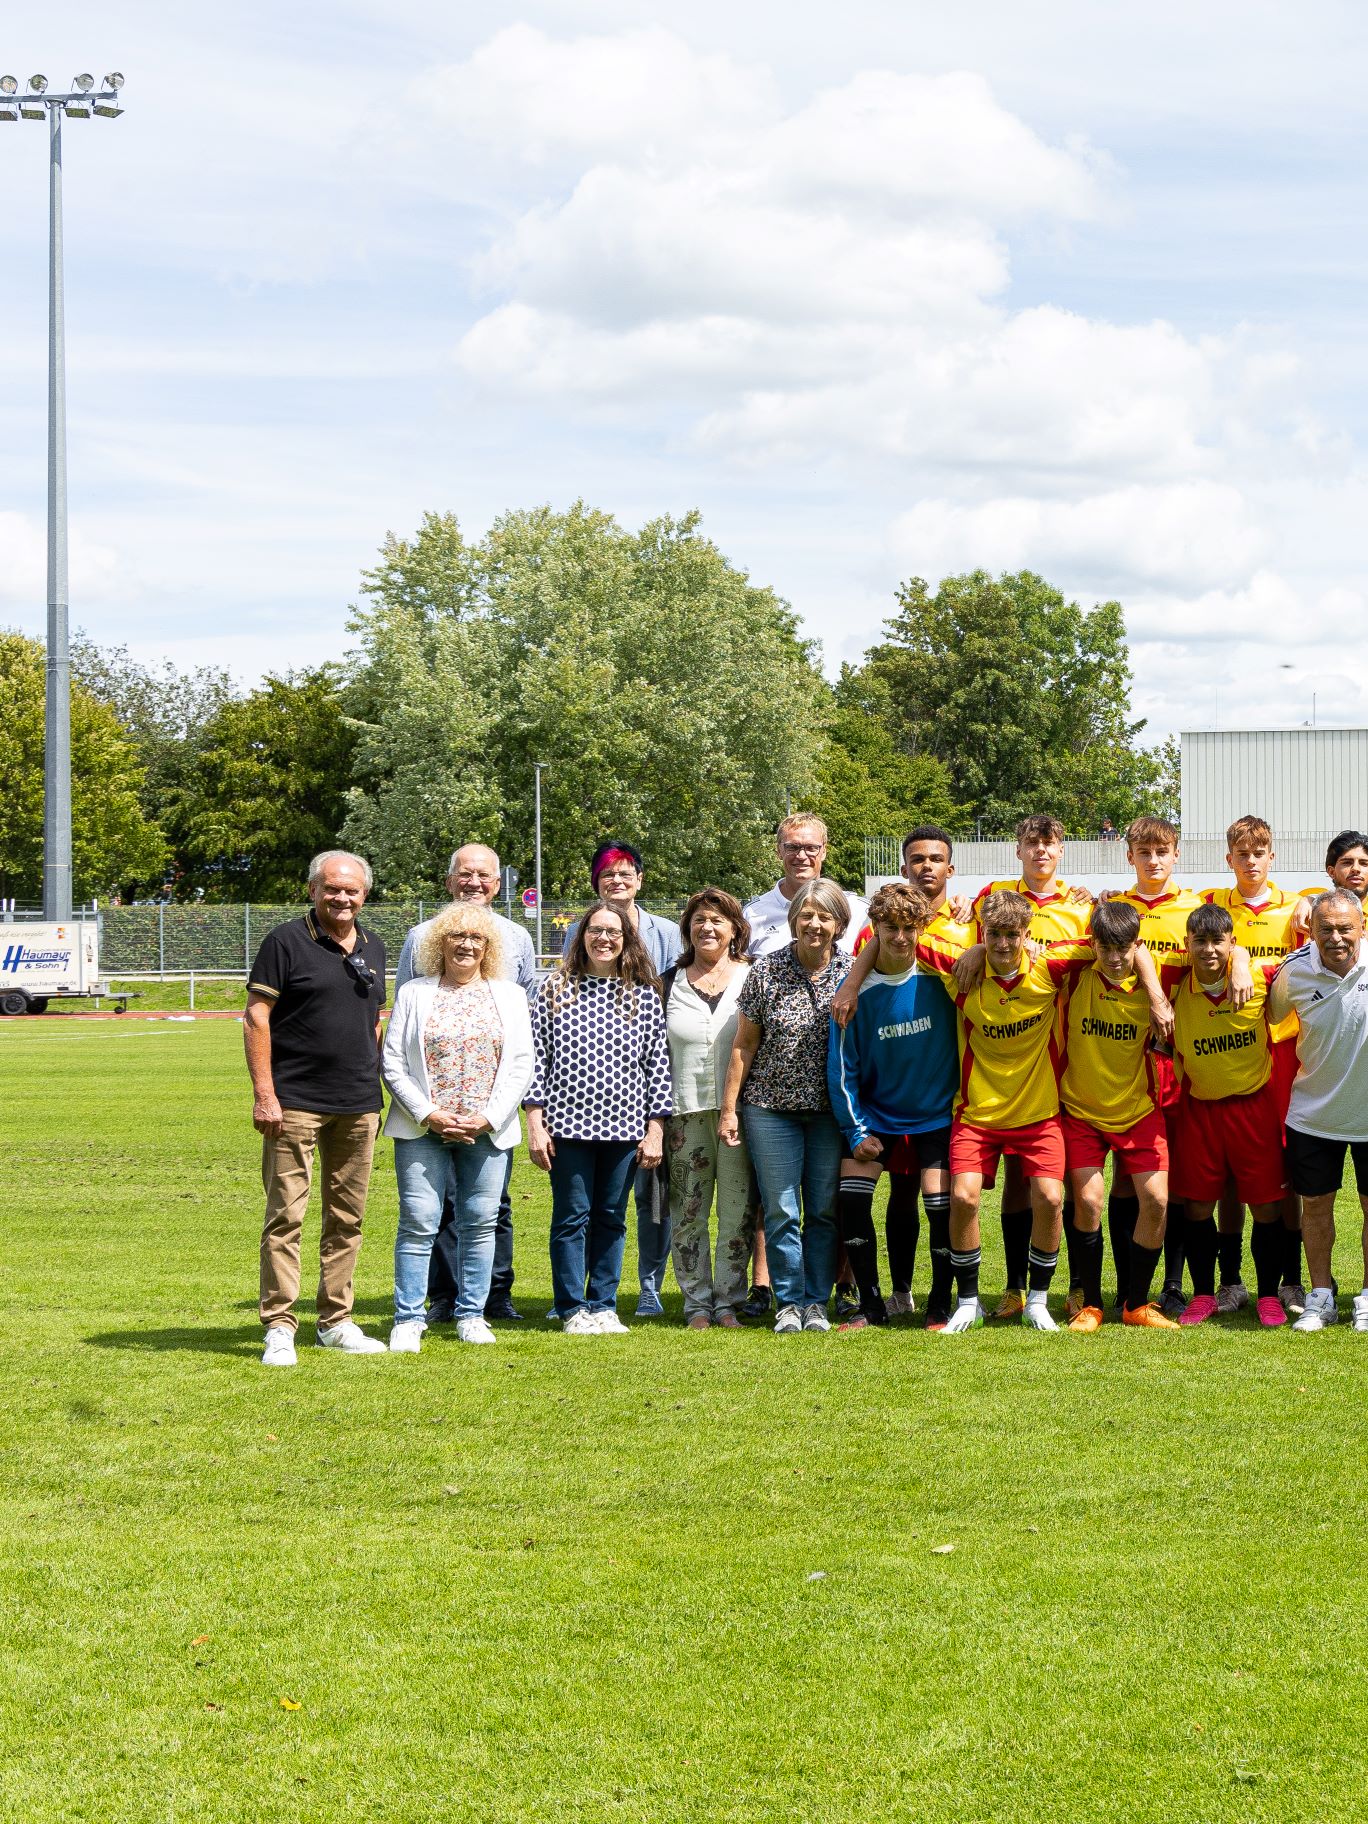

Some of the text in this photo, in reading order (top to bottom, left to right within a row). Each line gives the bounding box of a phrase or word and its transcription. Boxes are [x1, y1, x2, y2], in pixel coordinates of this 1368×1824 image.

[21, 949, 71, 960] Haumayr
[878, 1016, 932, 1041] SCHWABEN
[982, 1012, 1044, 1040] SCHWABEN
[1081, 1017, 1138, 1042] SCHWABEN
[1193, 1029, 1258, 1056] SCHWABEN
